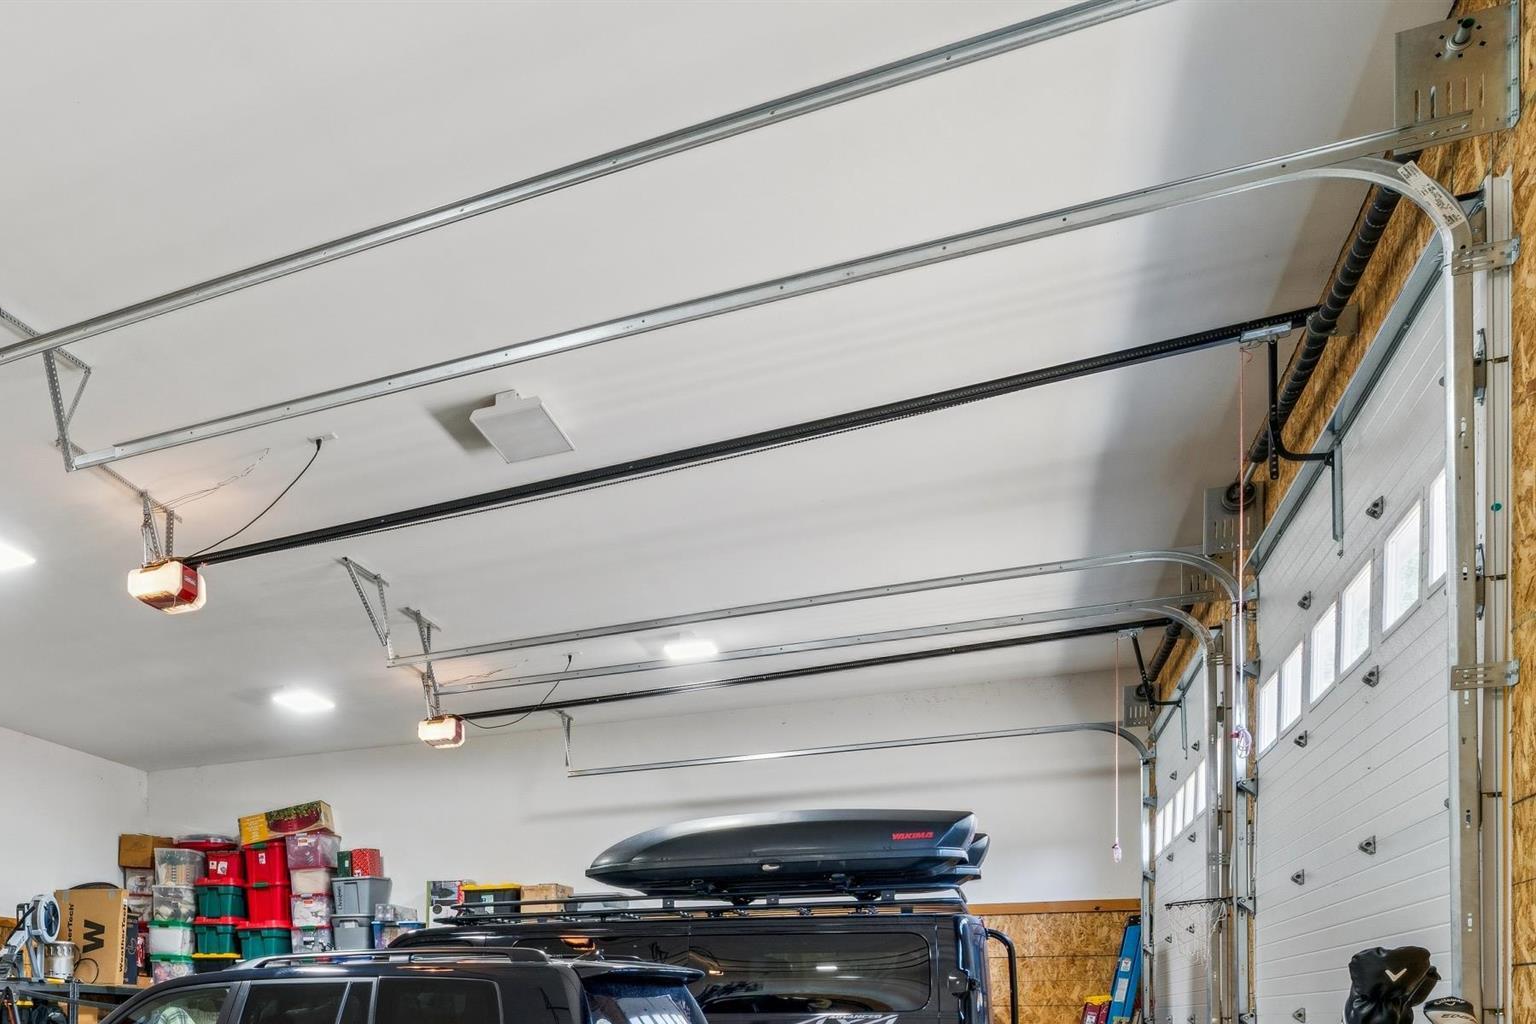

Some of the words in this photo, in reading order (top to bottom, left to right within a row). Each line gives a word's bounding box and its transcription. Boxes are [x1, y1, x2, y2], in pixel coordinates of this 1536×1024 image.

[892, 831, 934, 840] YAKIMA
[67, 903, 75, 941] erTech
[119, 904, 127, 973] WeatherTech
